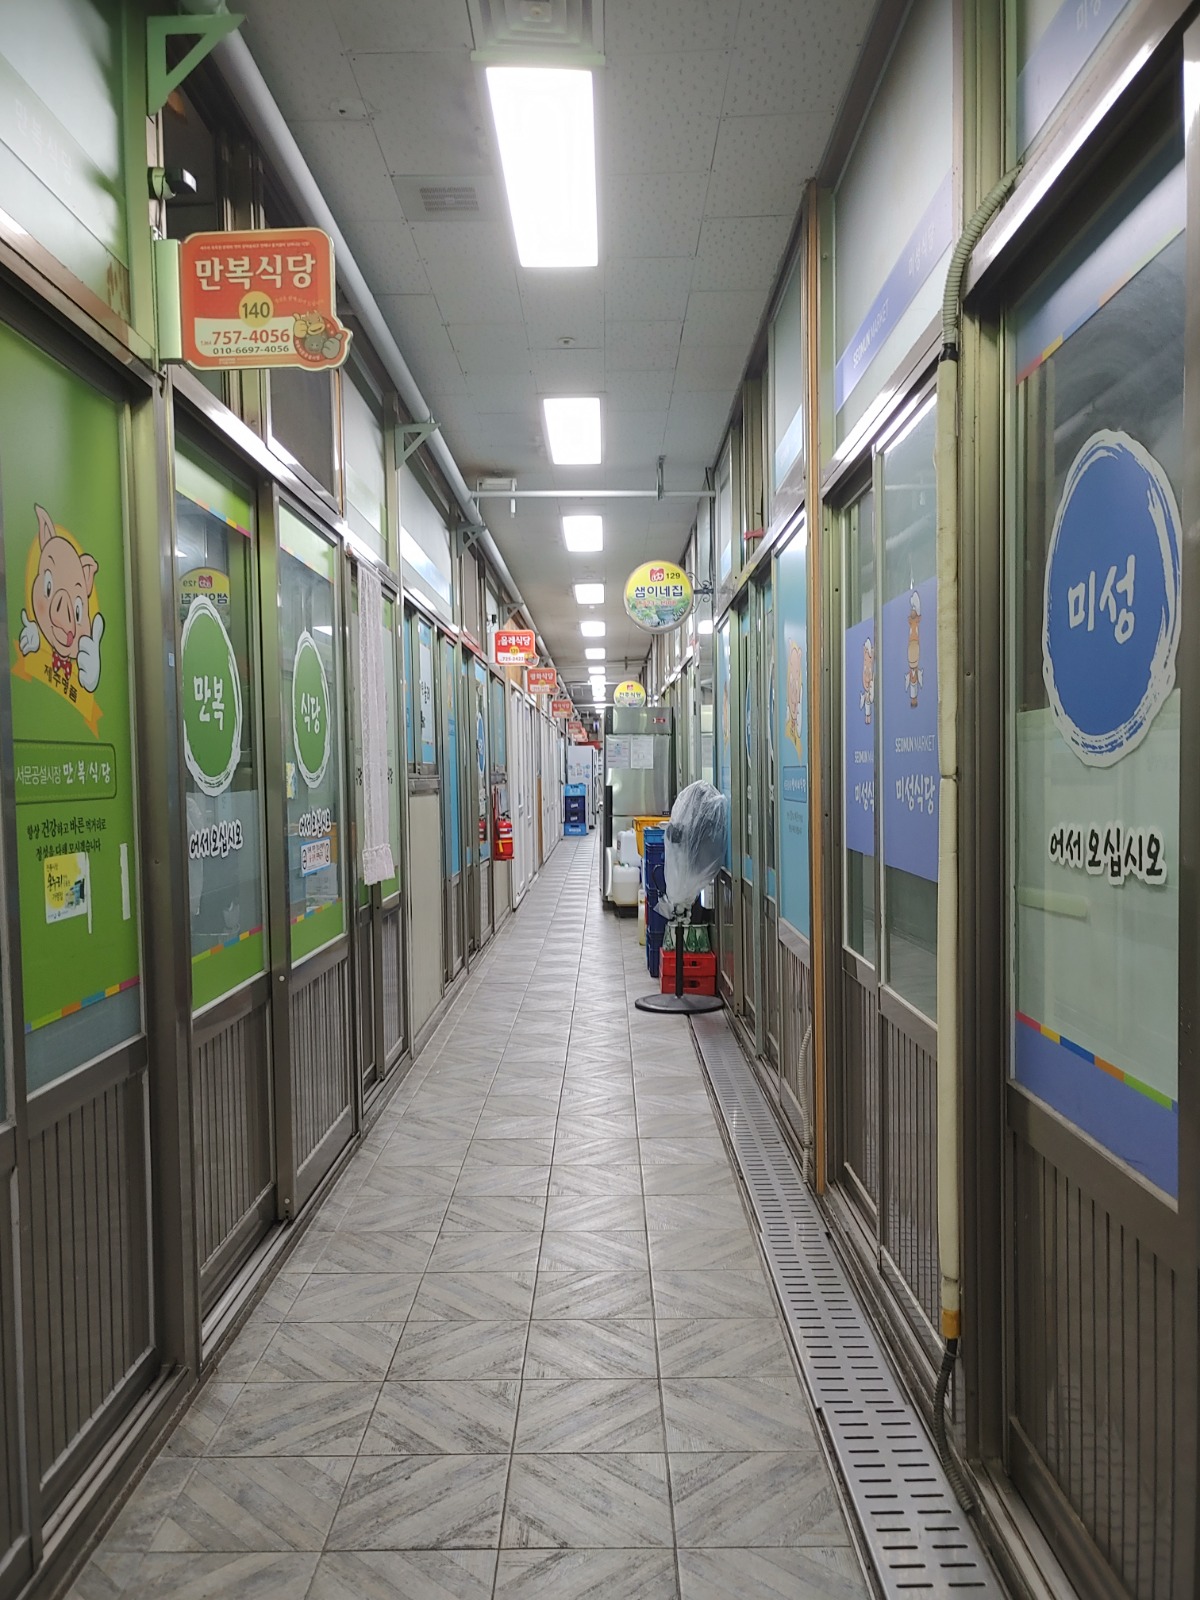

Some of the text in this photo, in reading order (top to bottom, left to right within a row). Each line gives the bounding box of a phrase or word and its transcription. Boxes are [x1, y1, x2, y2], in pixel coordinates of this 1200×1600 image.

[194, 253, 316, 291] 만복식당
[242, 301, 270, 319] 140
[212, 328, 290, 346] 757-4056
[212, 345, 290, 355] 010-6697-4056
[666, 572, 680, 580] 129
[634, 585, 683, 598] 샘이네집
[1066, 554, 1135, 644] 미성
[193, 675, 225, 731] 만복
[301, 692, 321, 734] 식당
[895, 735, 936, 753] SEOMUN MARKET
[16, 765, 61, 785] 서문공설시장
[895, 774, 936, 815] 미성식당
[27, 816, 107, 840] 항상 건강하고 바른 먹거리로
